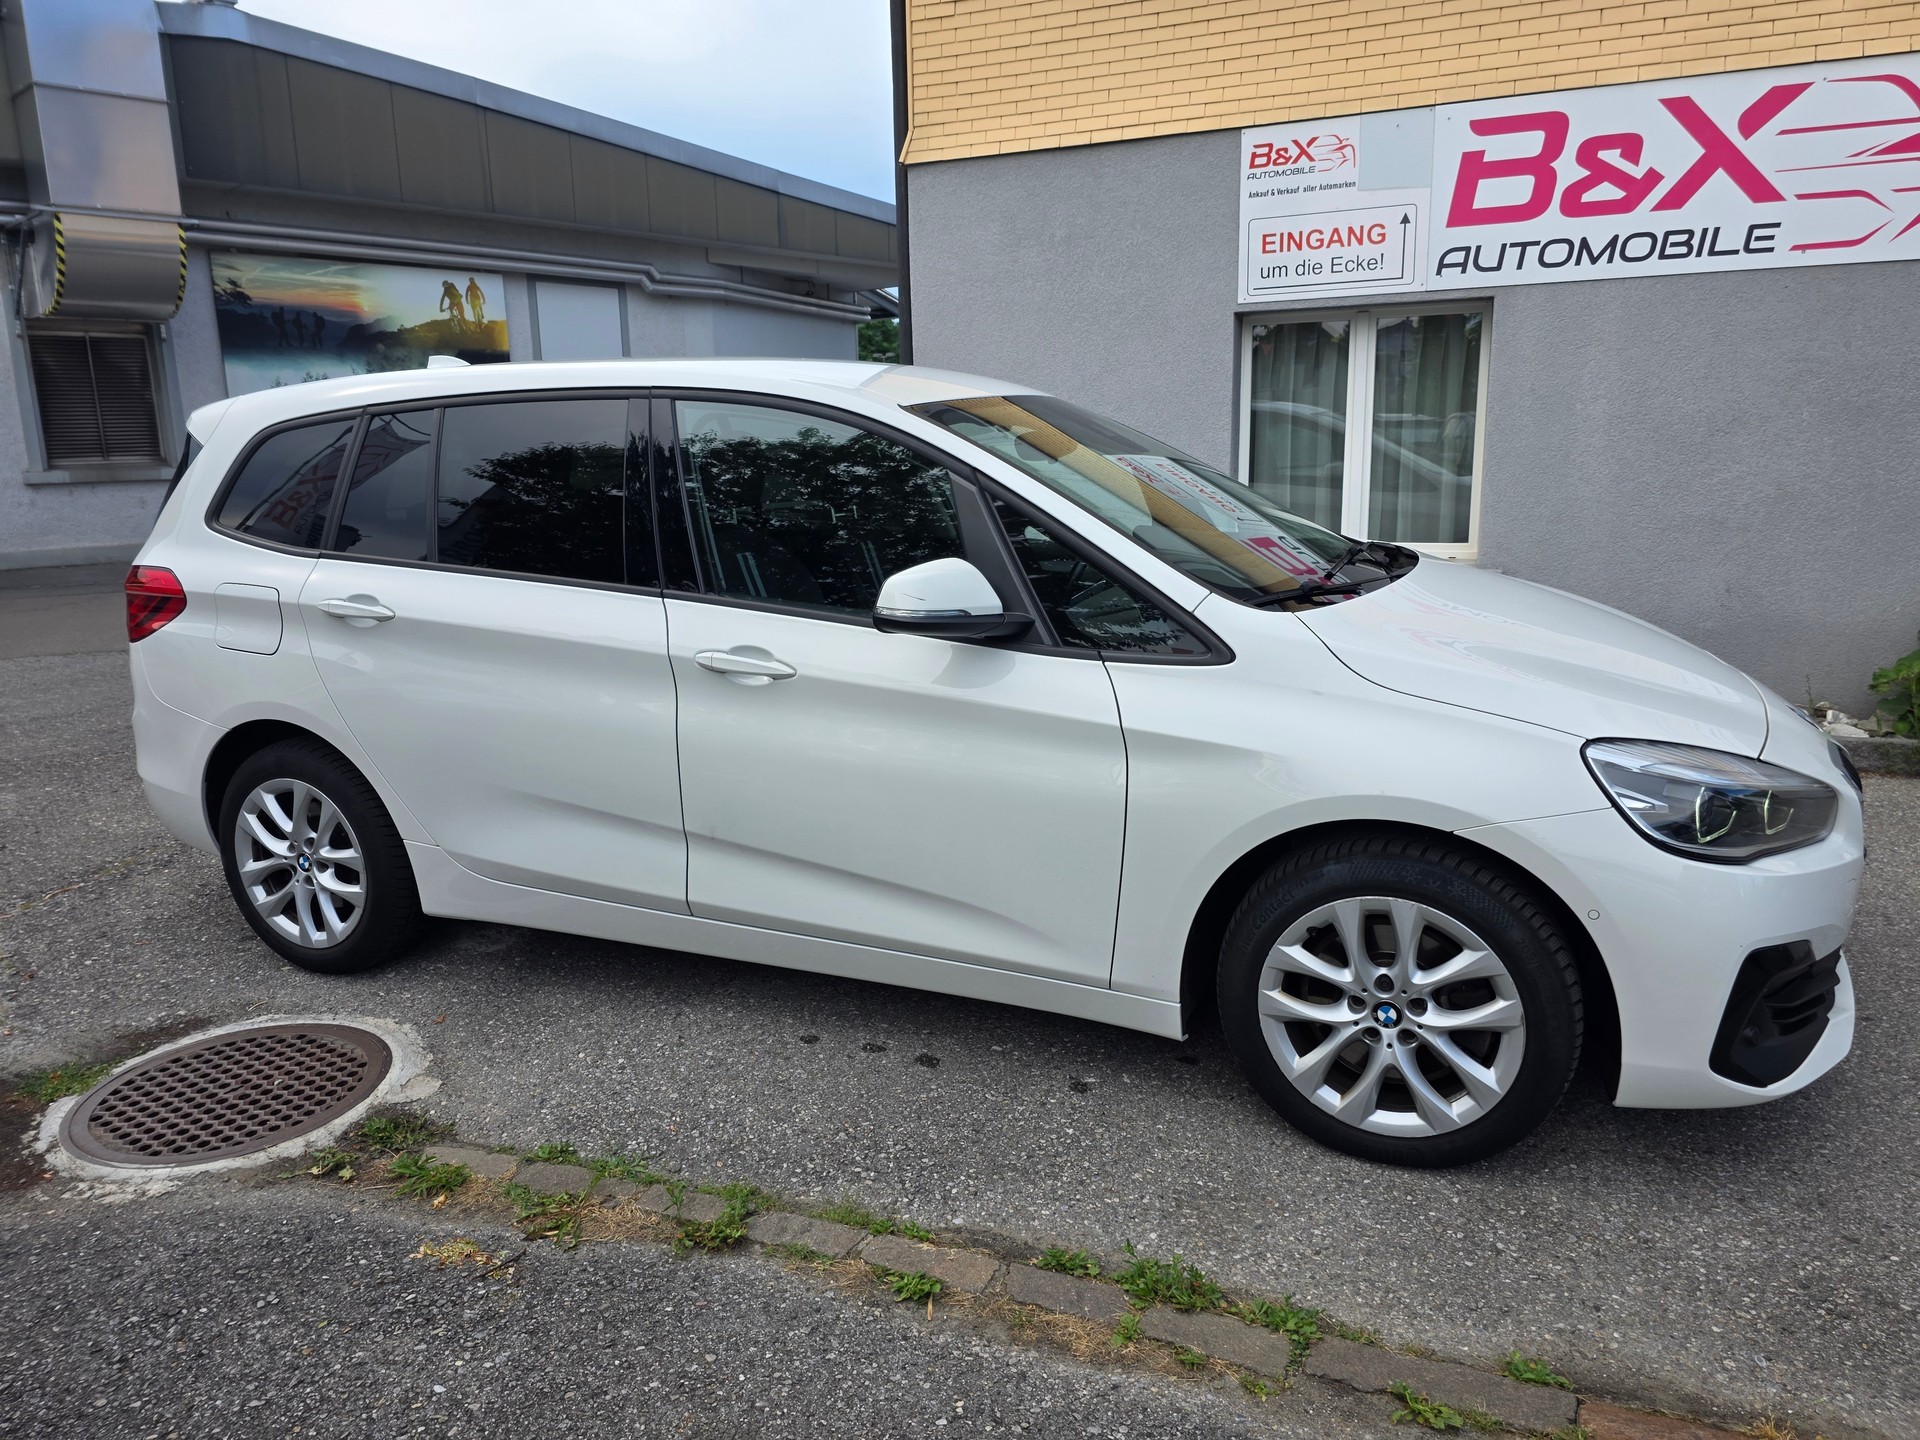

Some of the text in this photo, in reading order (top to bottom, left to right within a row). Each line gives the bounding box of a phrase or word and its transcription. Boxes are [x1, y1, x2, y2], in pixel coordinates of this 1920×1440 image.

[1249, 136, 1320, 169] B&X
[1445, 81, 1816, 228] B&X
[1247, 165, 1316, 180] AUTOMOBILE
[1248, 181, 1356, 199] Ankauf & Verkauf aller Automarken
[1261, 223, 1387, 254] EINGANG
[1435, 221, 1782, 276] AUTOMOBILE
[1260, 253, 1384, 279] um die Ecke!
